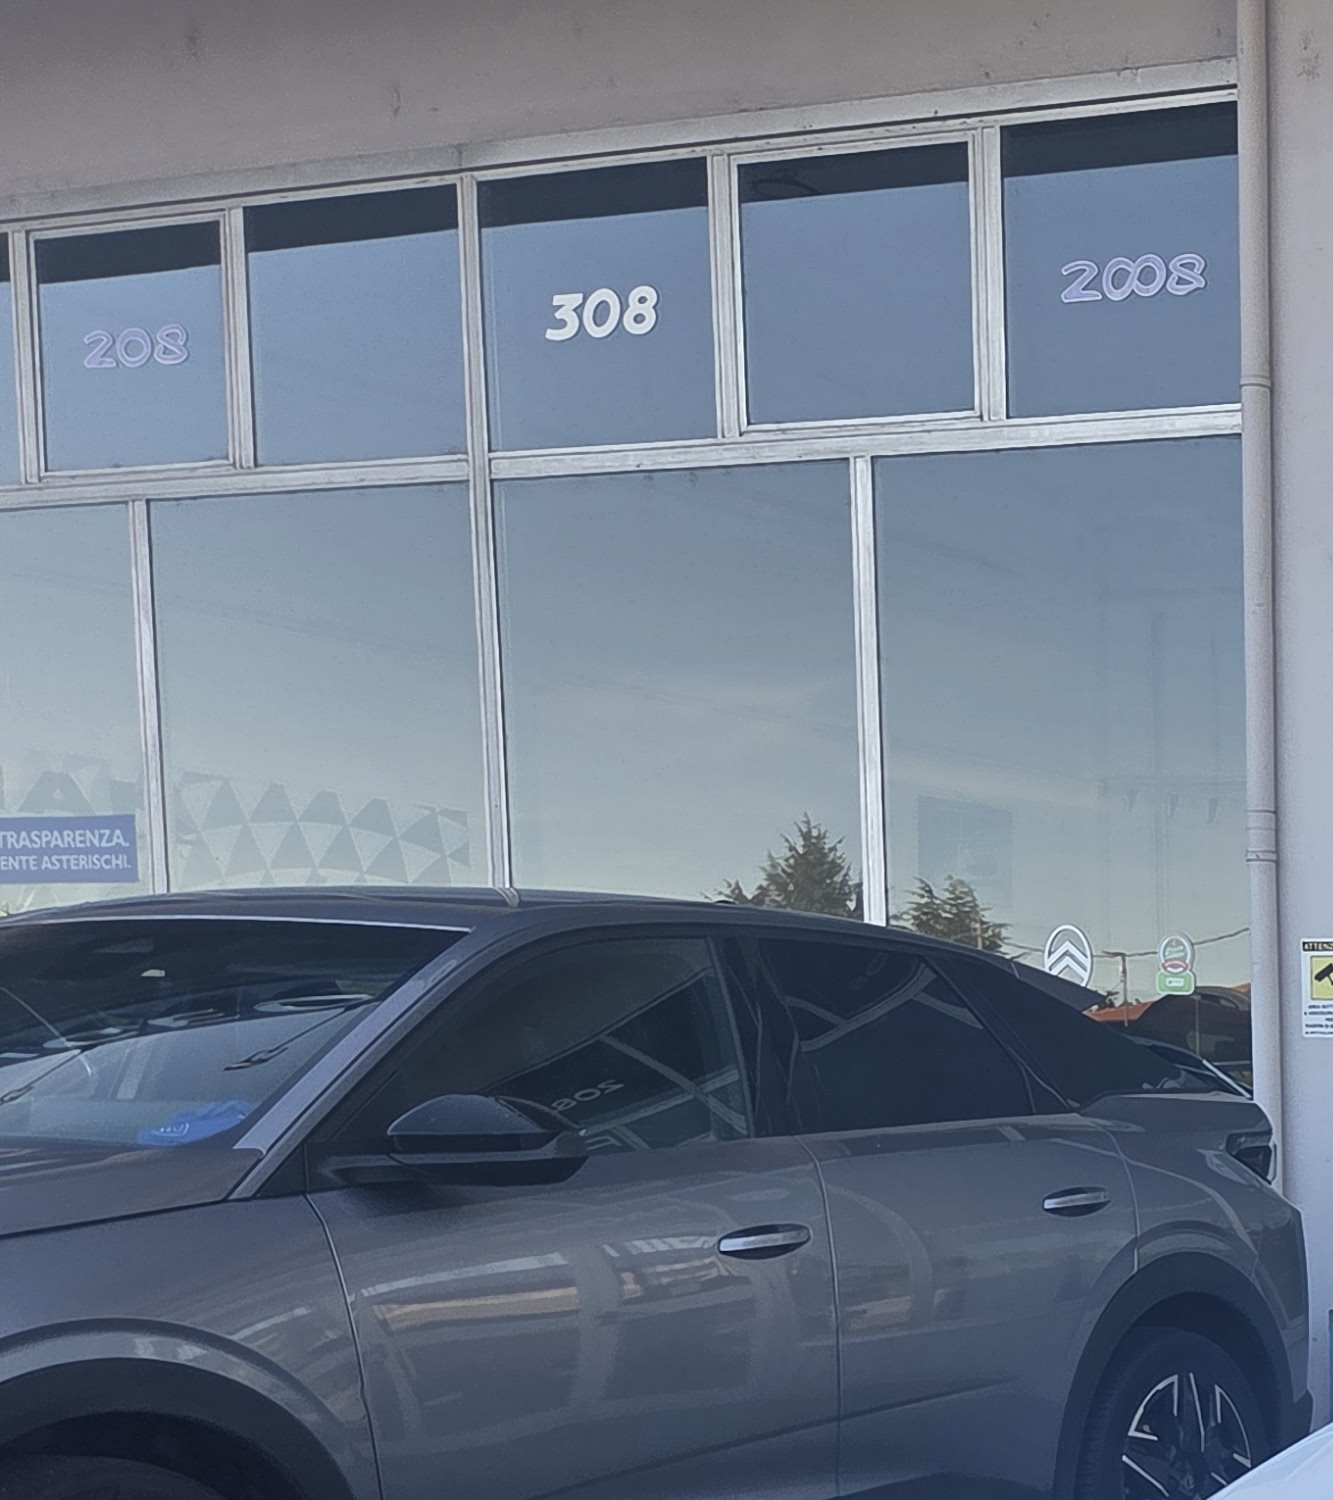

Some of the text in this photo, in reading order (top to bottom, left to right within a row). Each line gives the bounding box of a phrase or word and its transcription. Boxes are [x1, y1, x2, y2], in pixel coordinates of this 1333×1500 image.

[1060, 252, 1207, 303] 2008
[544, 285, 660, 342] 308
[82, 323, 191, 369] 208
